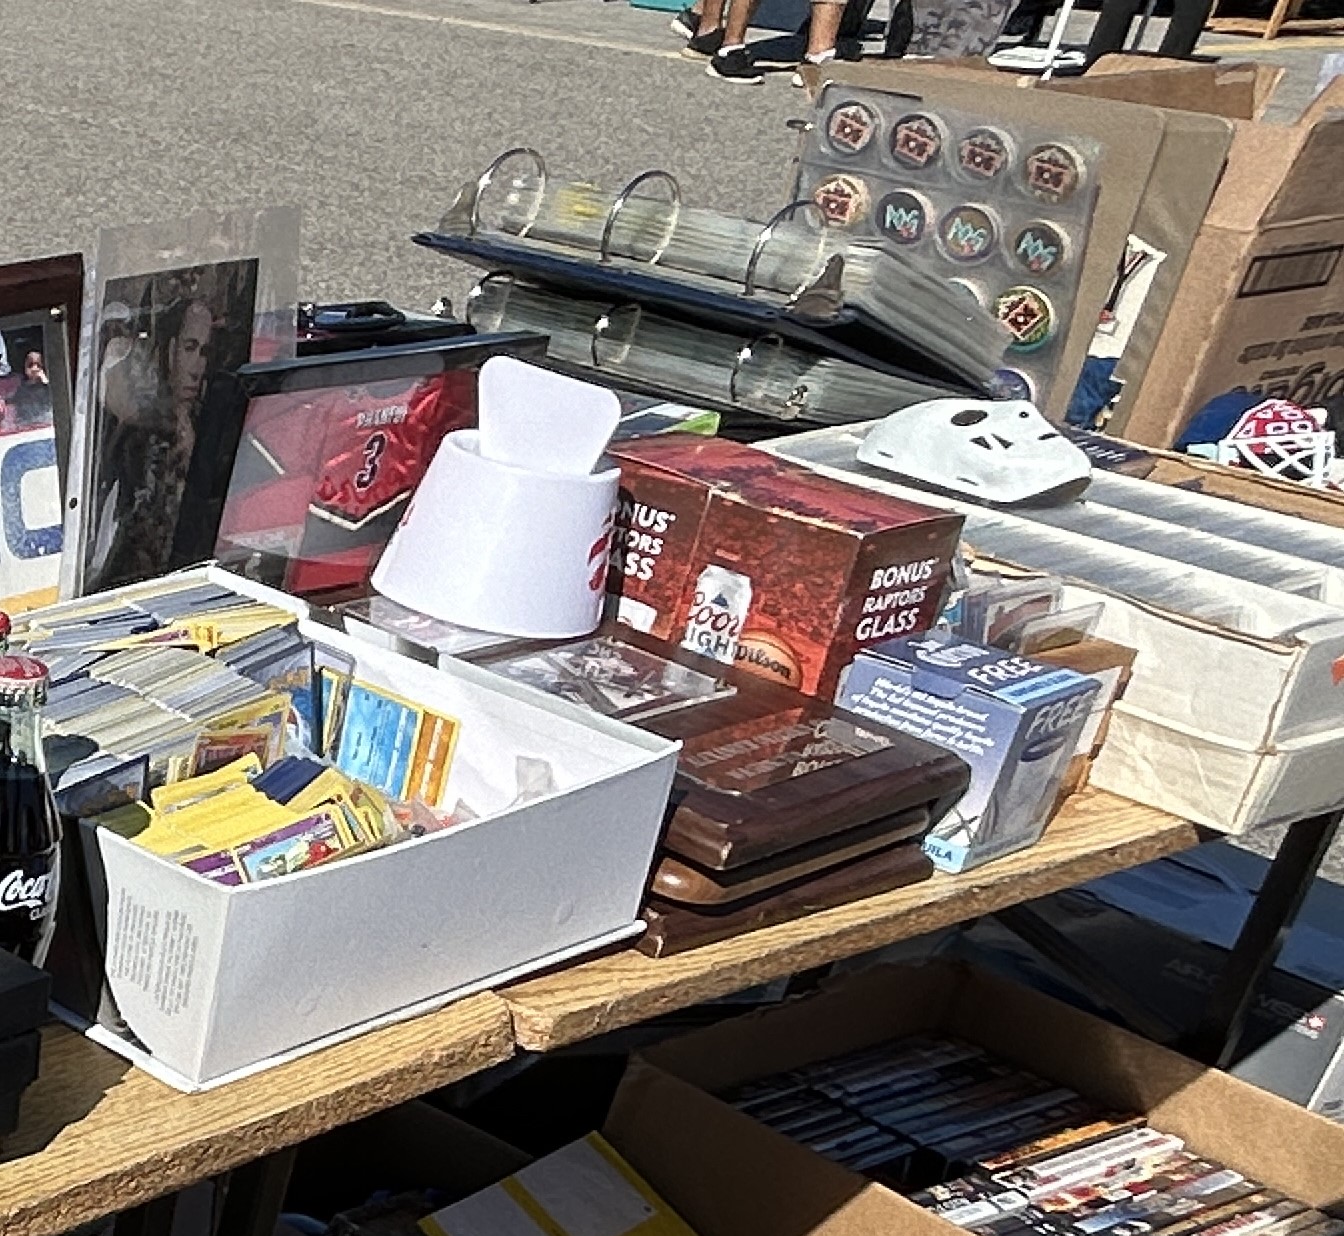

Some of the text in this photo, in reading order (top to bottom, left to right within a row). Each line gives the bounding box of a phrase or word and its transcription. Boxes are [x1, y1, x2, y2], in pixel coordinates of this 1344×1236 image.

[354, 430, 388, 493] 3
[862, 585, 929, 615] RAPTORS
[855, 608, 921, 642] GLASS
[966, 656, 1044, 686] FREE
[1024, 689, 1096, 742] FREE
